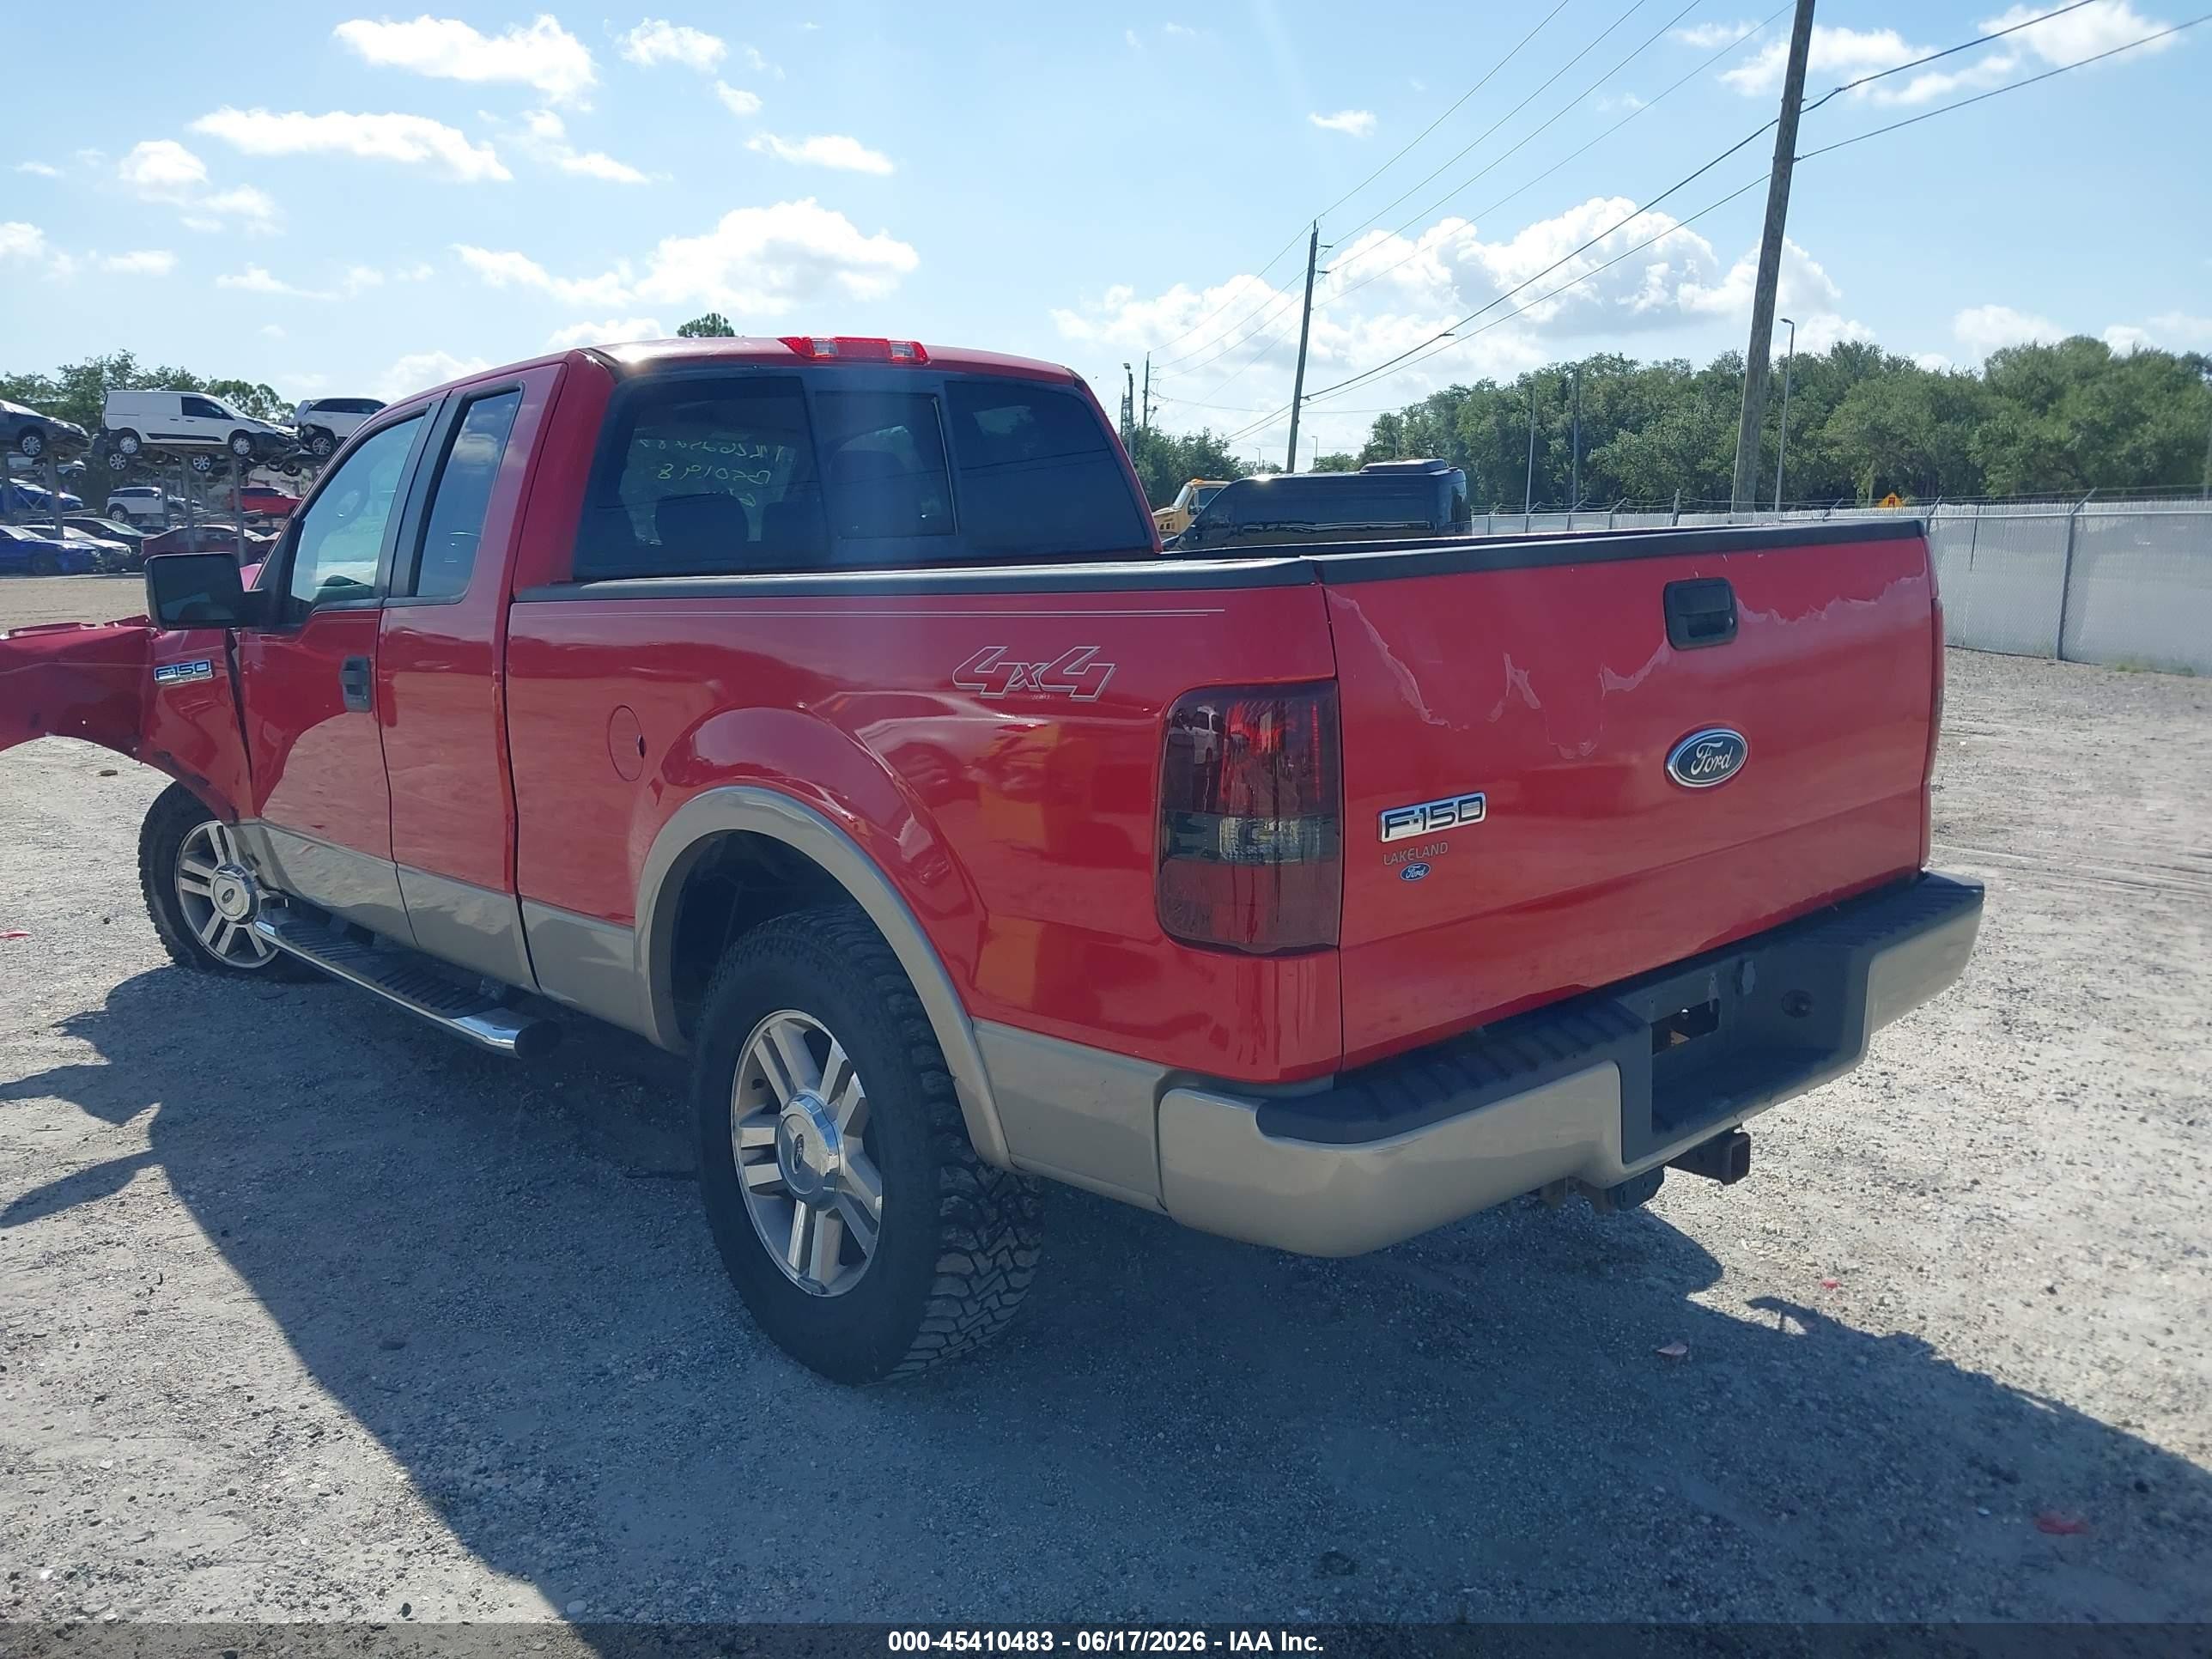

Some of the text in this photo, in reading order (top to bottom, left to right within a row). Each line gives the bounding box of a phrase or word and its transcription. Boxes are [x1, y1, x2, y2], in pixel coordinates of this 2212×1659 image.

[952, 646, 1116, 701] 4x4
[1690, 741, 1734, 775] Ford
[1384, 795, 1484, 839] F-150
[1382, 842, 1449, 866] LAKELAND
[1405, 865, 1426, 879] Ford
